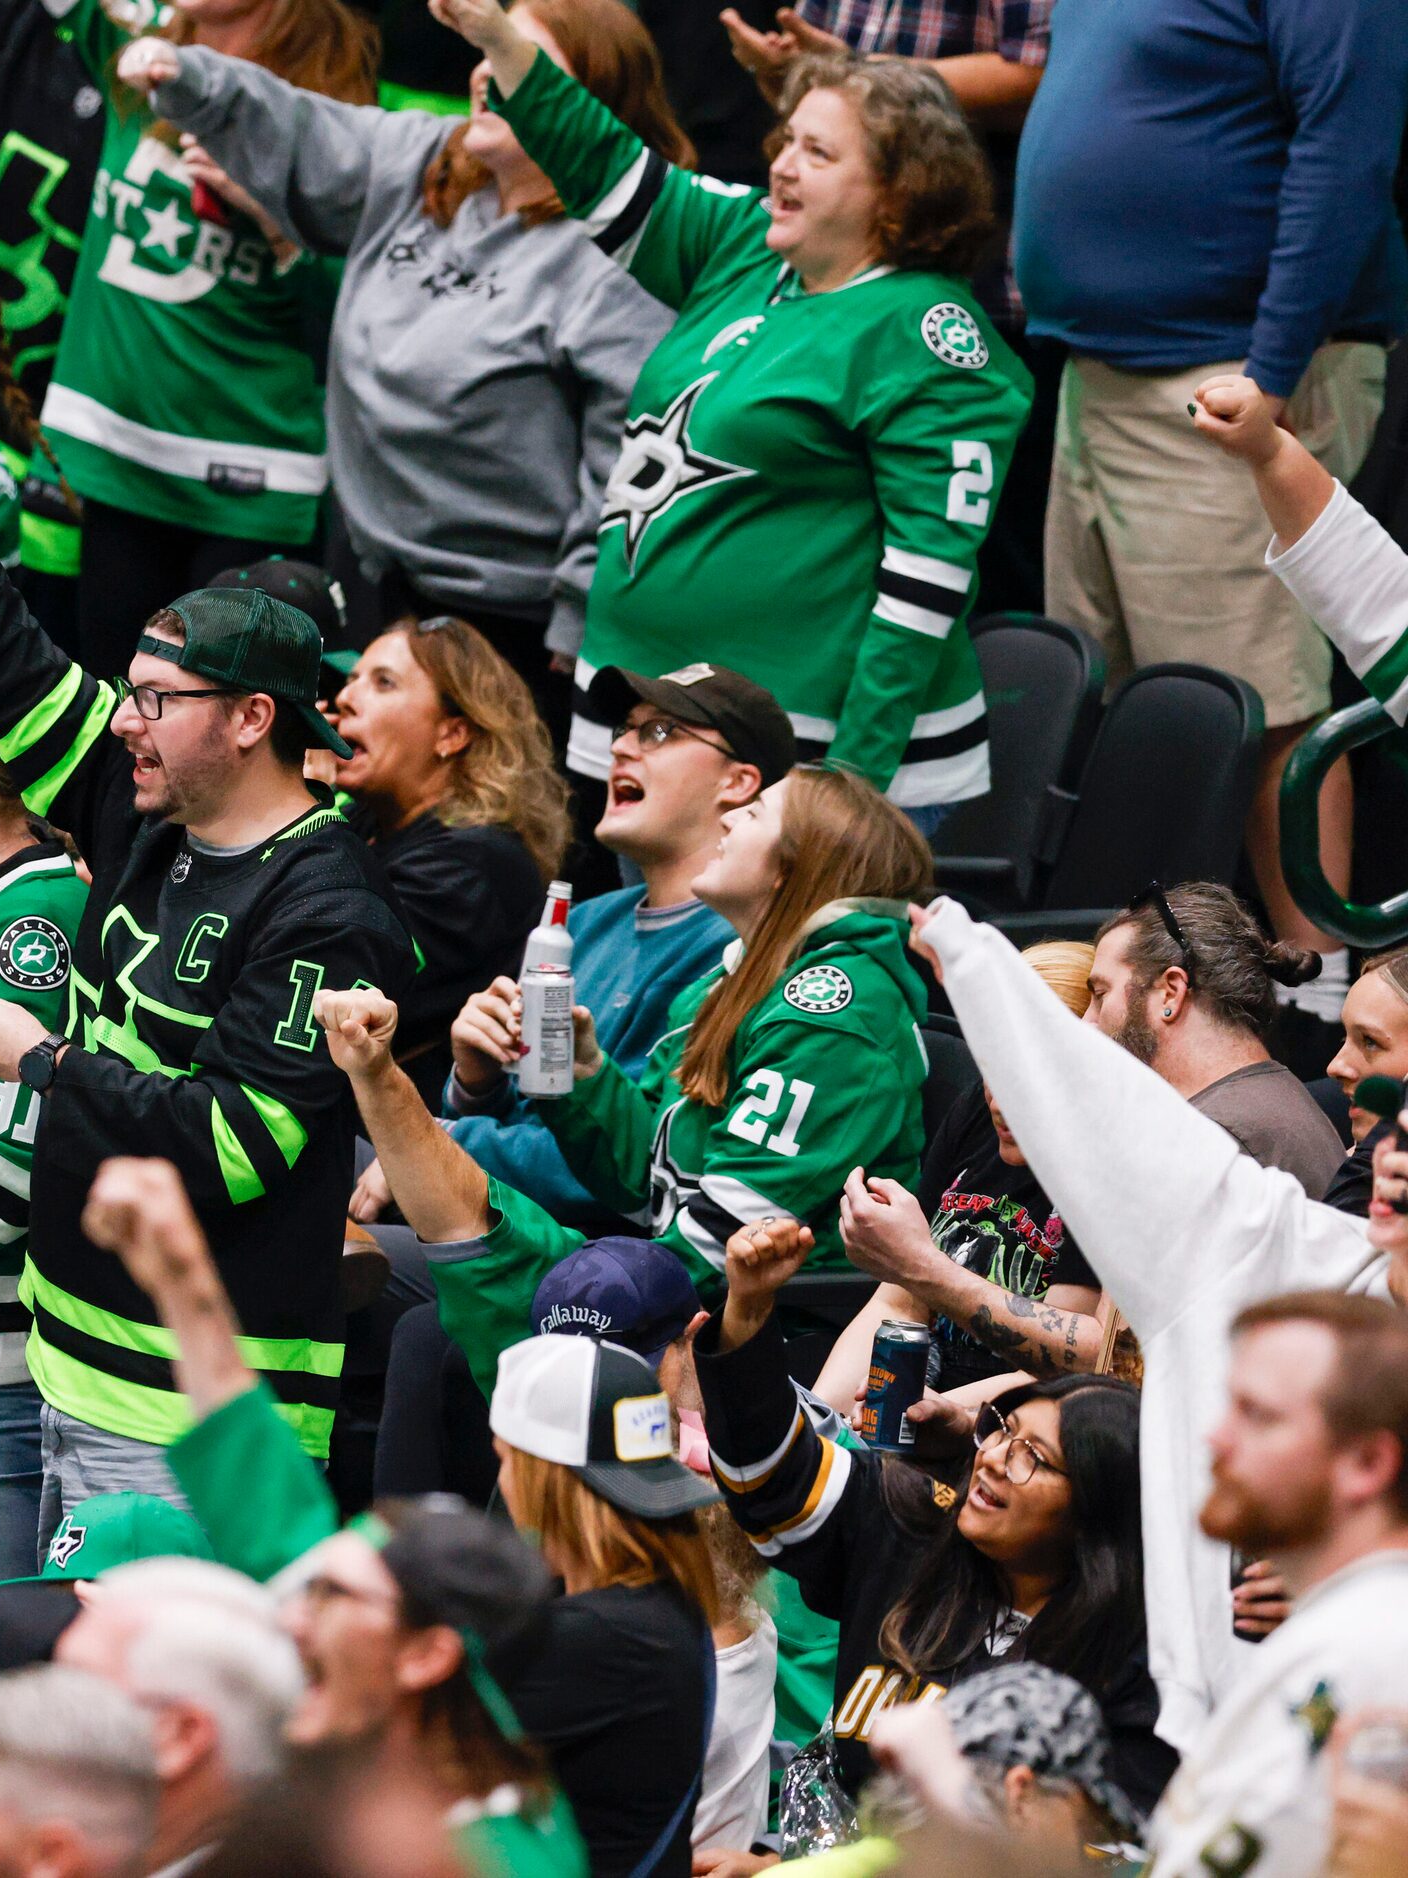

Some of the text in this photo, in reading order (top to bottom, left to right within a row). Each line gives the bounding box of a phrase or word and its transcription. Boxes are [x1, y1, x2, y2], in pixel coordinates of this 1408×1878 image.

[946, 439, 993, 527] 2
[1, 922, 66, 952] DALLAS
[175, 912, 229, 984] C
[5, 966, 64, 985] STARS
[727, 1068, 816, 1157] 21
[540, 1303, 612, 1334] Callaway
